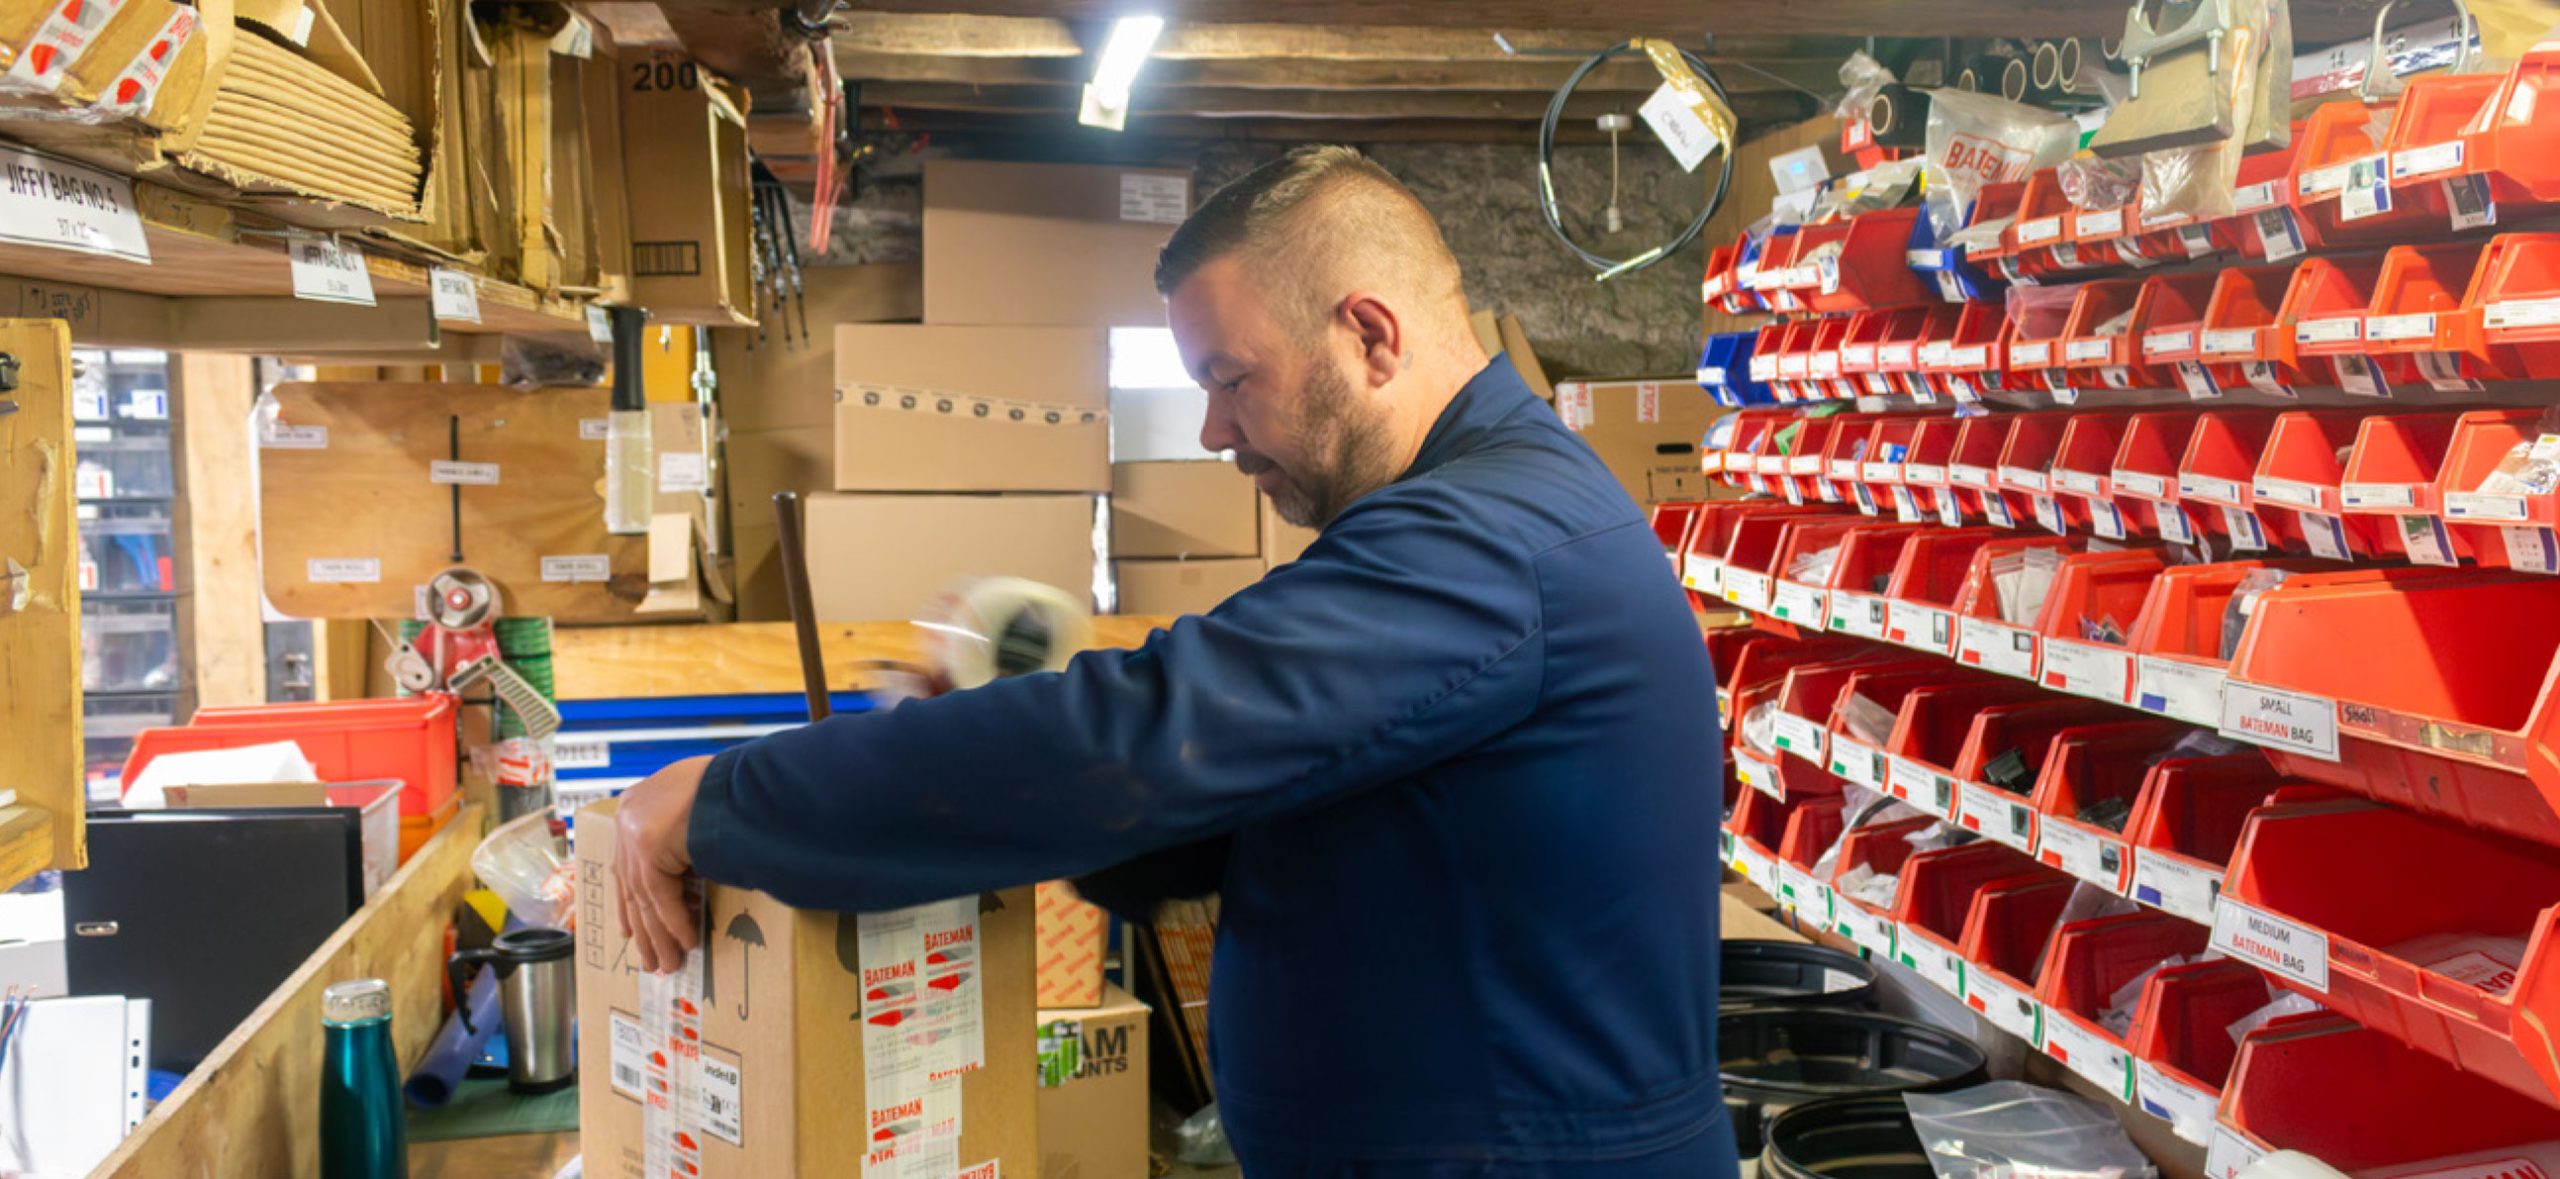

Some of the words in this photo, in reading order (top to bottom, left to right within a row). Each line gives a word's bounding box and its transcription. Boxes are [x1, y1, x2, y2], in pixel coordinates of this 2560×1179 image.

[634, 62, 698, 91] 200
[7, 162, 46, 198] JIFFY
[48, 171, 84, 206] BAG
[2259, 697, 2292, 716] SMALL
[2240, 716, 2289, 738] BATEMAN
[2291, 726, 2314, 744] BAG
[924, 923, 973, 952] BATEMAN
[2248, 916, 2291, 944] MEDIUM
[2232, 933, 2281, 964] BATEMAN
[2283, 953, 2305, 973] BAG
[865, 958, 915, 987] BATEMAN
[871, 1097, 922, 1128] BATEMAN
